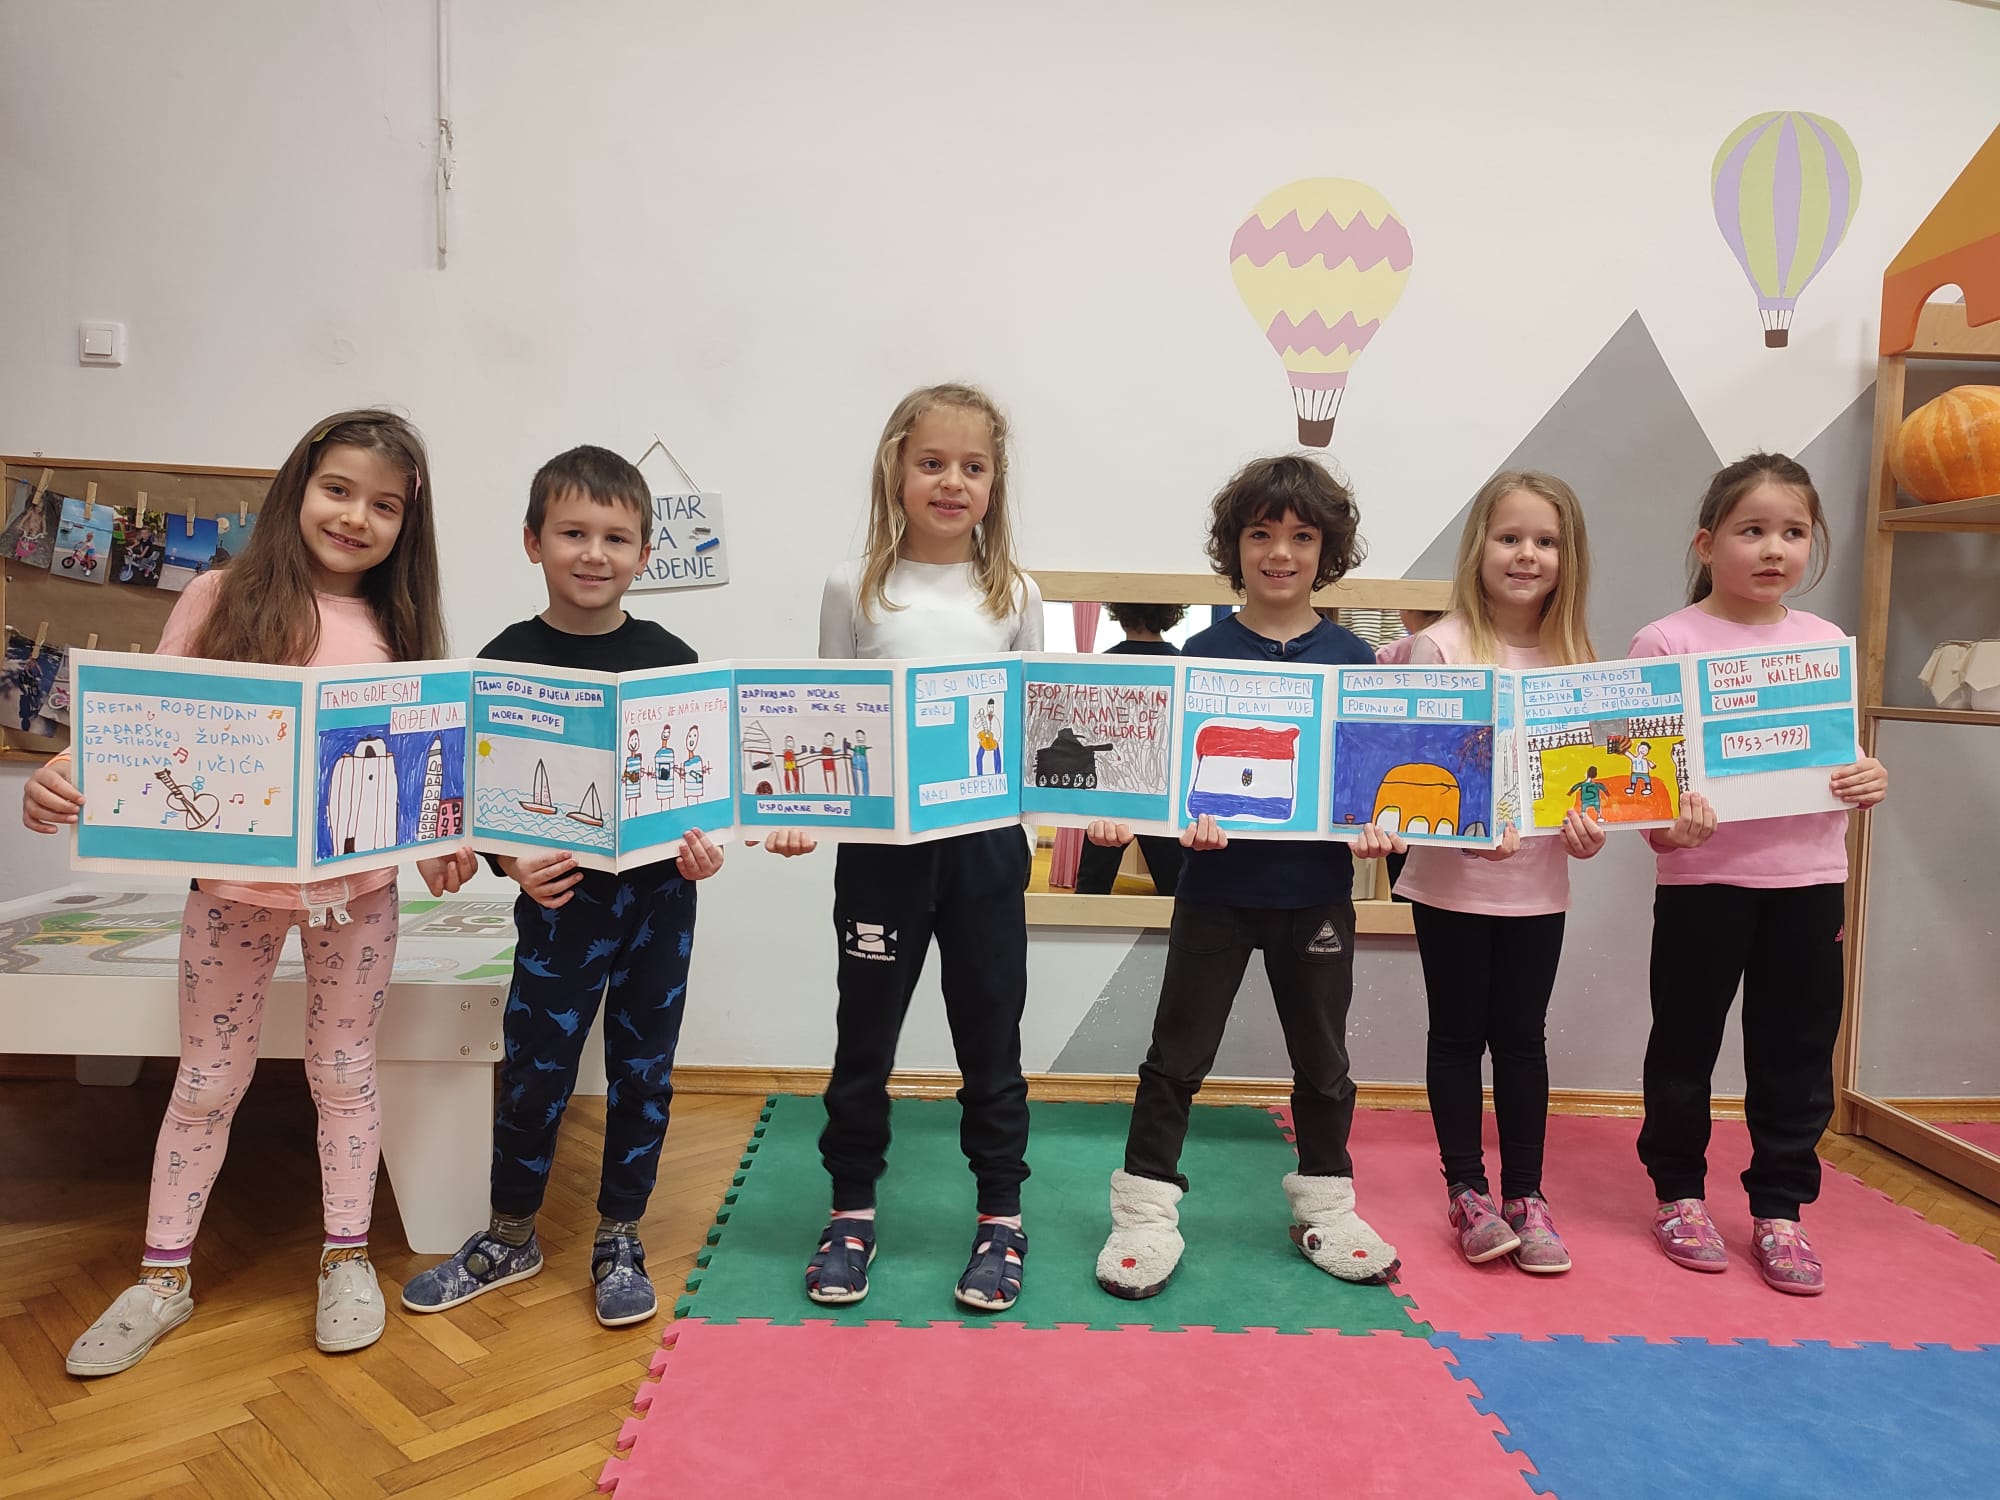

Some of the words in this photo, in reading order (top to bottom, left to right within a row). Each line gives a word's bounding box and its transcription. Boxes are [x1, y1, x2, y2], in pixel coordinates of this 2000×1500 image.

[650, 526, 677, 551] A
[634, 556, 716, 582] AĐENJE
[1709, 660, 1749, 676] TVOJE
[1761, 654, 1802, 668] PJESME
[1344, 675, 1384, 689] TAMO
[1394, 673, 1411, 687] SE
[1424, 673, 1480, 689] PJESME
[1525, 680, 1552, 690] NEKA
[1560, 678, 1574, 688] JE
[1582, 670, 1636, 683] MLADOST
[1714, 675, 1752, 688] OSTAJU
[1767, 662, 1838, 685] KALELARGU
[323, 689, 358, 708] TAMO
[363, 684, 388, 702] GDJE
[392, 680, 420, 703] SAM
[476, 680, 502, 692] TAMO
[507, 681, 533, 695] GDJE
[539, 688, 570, 701] BIJELA
[575, 692, 602, 702] JEDRA
[916, 679, 937, 700] SVI
[943, 678, 957, 692] SU
[967, 672, 1006, 690] NJEGA
[1191, 675, 1240, 694] TAMO
[1245, 681, 1263, 695] SE
[1269, 677, 1311, 695] CRVEN
[1603, 687, 1648, 698] TOBOM
[1027, 684, 1061, 699] STOP
[1065, 684, 1099, 701] THE
[1105, 687, 1147, 705] WAR
[1151, 690, 1168, 708] IN
[1188, 695, 1223, 713] BIJELI
[1238, 702, 1271, 712] PLAVI
[1287, 701, 1312, 714] VIJE
[1714, 695, 1755, 710] ČUVAJU
[86, 700, 143, 714] SRETAN
[160, 699, 257, 721] ROĐENDAN
[741, 705, 747, 713] U
[833, 703, 847, 714] SE
[856, 702, 889, 713] STARE
[1072, 707, 1129, 725] NAME
[1139, 710, 1158, 726] OF
[1419, 700, 1461, 718] PRIJE
[1525, 708, 1552, 718] KADA
[1564, 704, 1590, 715] VEĆ
[1602, 700, 1617, 710] NE
[1619, 698, 1659, 708] MOGU
[1666, 696, 1681, 705] JA
[391, 705, 441, 731] ROĐEN
[532, 714, 560, 727] PLOVE
[85, 736, 103, 746] UZ
[115, 735, 171, 749] STIHOVE
[86, 723, 180, 743] ZADARSKOJ
[196, 727, 270, 746] ŽUPANIJI
[1093, 725, 1156, 740] CHILDREN
[85, 752, 173, 767] TOMISLAVA
[960, 778, 1007, 796] BEREKIN
[1586, 785, 1596, 800] 5
[823, 803, 850, 815] BUDE
